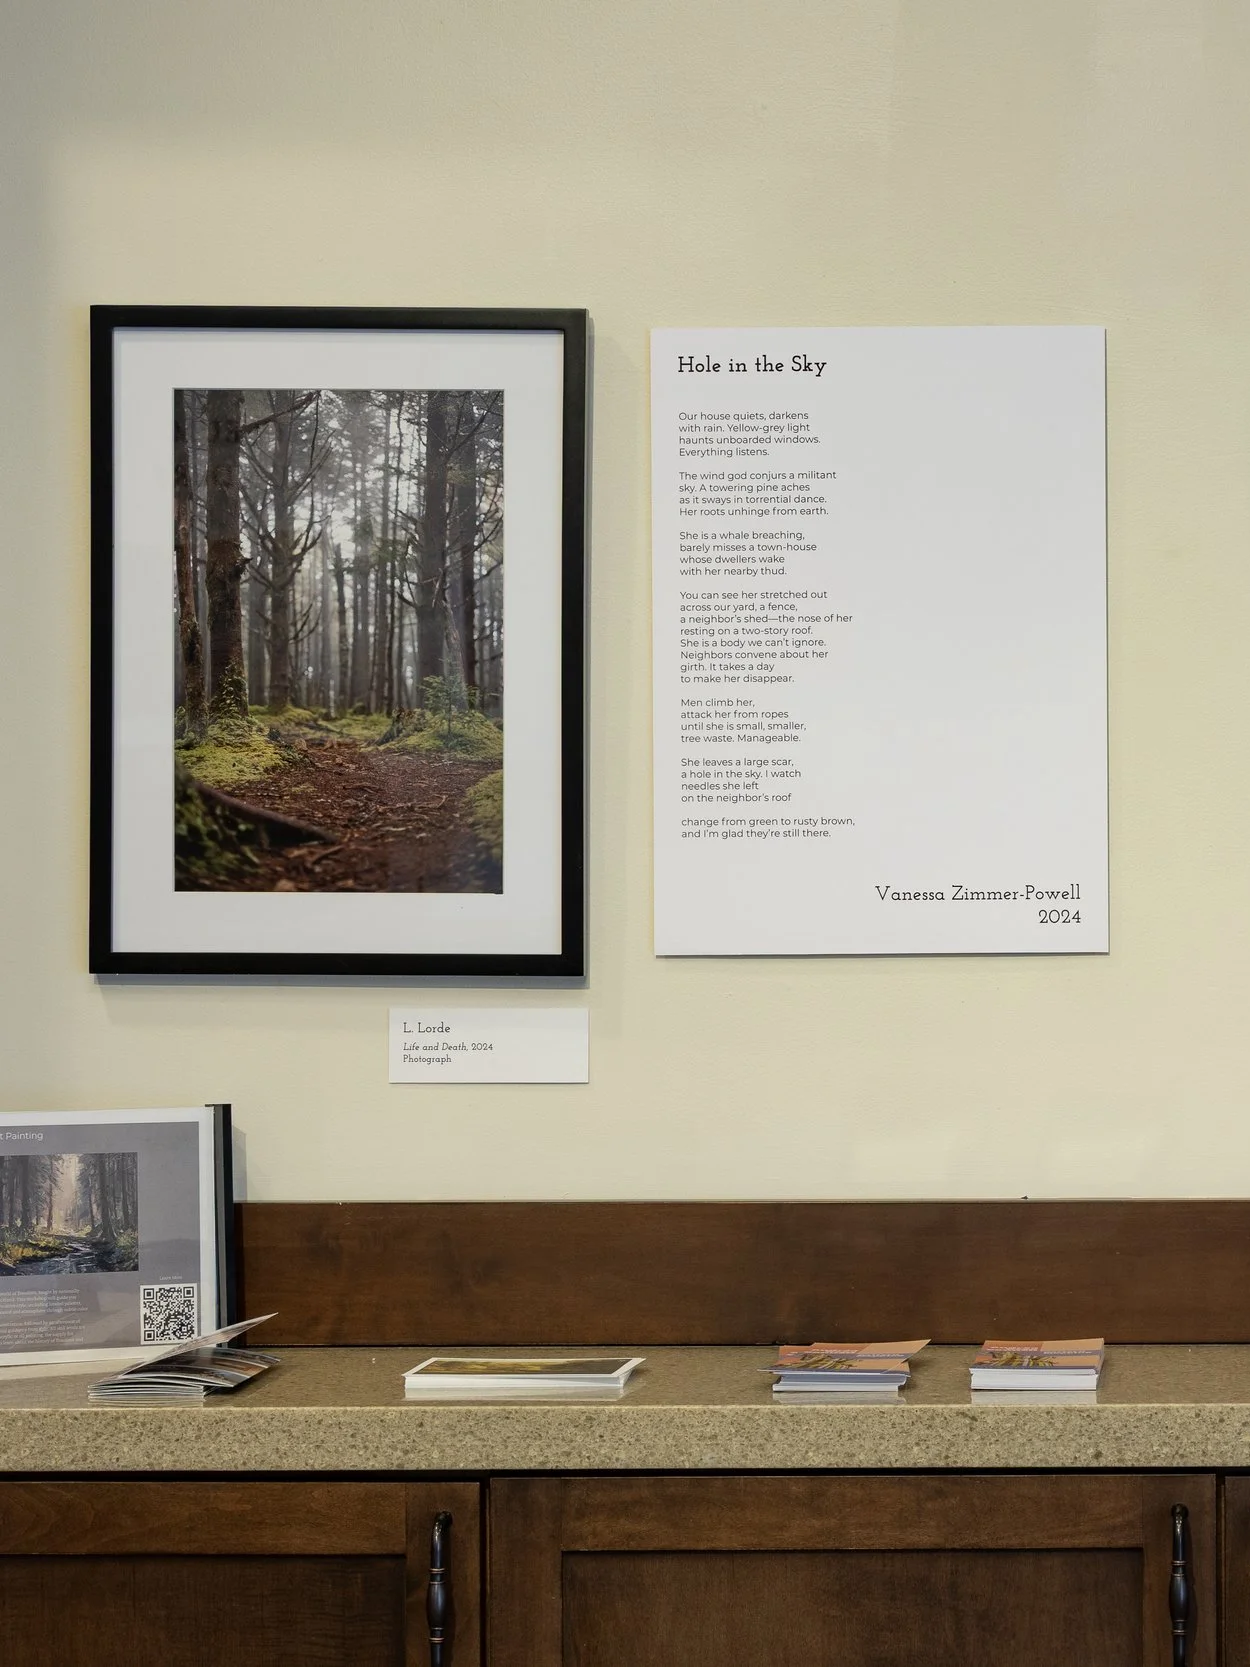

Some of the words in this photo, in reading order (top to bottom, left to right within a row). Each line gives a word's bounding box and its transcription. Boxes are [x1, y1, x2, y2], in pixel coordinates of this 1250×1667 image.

[678, 355, 722, 373] Hole
[729, 358, 748, 373] in
[755, 354, 784, 372] the
[792, 354, 827, 377] Sky
[679, 412, 698, 421] Our
[701, 412, 731, 421] house
[733, 412, 767, 422] quiets,
[769, 411, 809, 420] darkens
[679, 424, 701, 433] with
[704, 424, 725, 433] rain.
[727, 424, 785, 434] Yellow-grey
[788, 423, 810, 434] light
[679, 436, 714, 445] haunts
[716, 435, 772, 444] unboarded
[774, 435, 821, 444] windows.
[680, 448, 733, 458] Everything
[736, 447, 770, 456] listens.
[693, 496, 699, 504] it
[702, 497, 731, 506] sways
[734, 495, 743, 504] in
[746, 495, 791, 504] torrential
[794, 495, 827, 504] dance.
[680, 508, 698, 516] Her
[728, 507, 770, 518] unhinge
[773, 507, 797, 516] from
[800, 506, 829, 516] earth.
[680, 543, 711, 554] barely
[713, 543, 747, 552] misses
[758, 543, 817, 552] town-house
[680, 555, 713, 564] whose
[715, 555, 757, 564] dwellers
[759, 555, 785, 563] wake
[681, 627, 715, 637] resting
[742, 628, 789, 637] two-story
[792, 626, 813, 635] roof.
[681, 650, 733, 661] Neighbors
[780, 650, 809, 659] about
[812, 650, 829, 659] her
[694, 674, 721, 683] make
[724, 674, 741, 683] her
[743, 674, 795, 684] disappear.
[681, 722, 704, 731] until
[706, 722, 724, 731] she
[727, 722, 734, 731] is
[736, 722, 765, 731] small,
[768, 722, 807, 731] smaller,
[703, 735, 735, 743] waste.
[738, 734, 801, 745] Manageable.
[682, 818, 719, 828] change
[722, 817, 746, 826] from
[749, 819, 778, 828] green
[781, 818, 791, 826] to
[794, 818, 819, 827] rusty
[821, 817, 855, 826] brown,
[875, 886, 946, 901] Vanessa
[952, 884, 1081, 901] Zimmer-Powell
[1039, 909, 1082, 924] 2024
[403, 1022, 414, 1033] L.
[418, 1022, 451, 1033] Lorde
[403, 1042, 420, 1051] Life
[422, 1042, 439, 1051] and
[442, 1042, 469, 1052] Death,
[471, 1043, 493, 1051] 2024
[403, 1054, 452, 1066] Photograph
[5, 1132, 44, 1141] Painting
